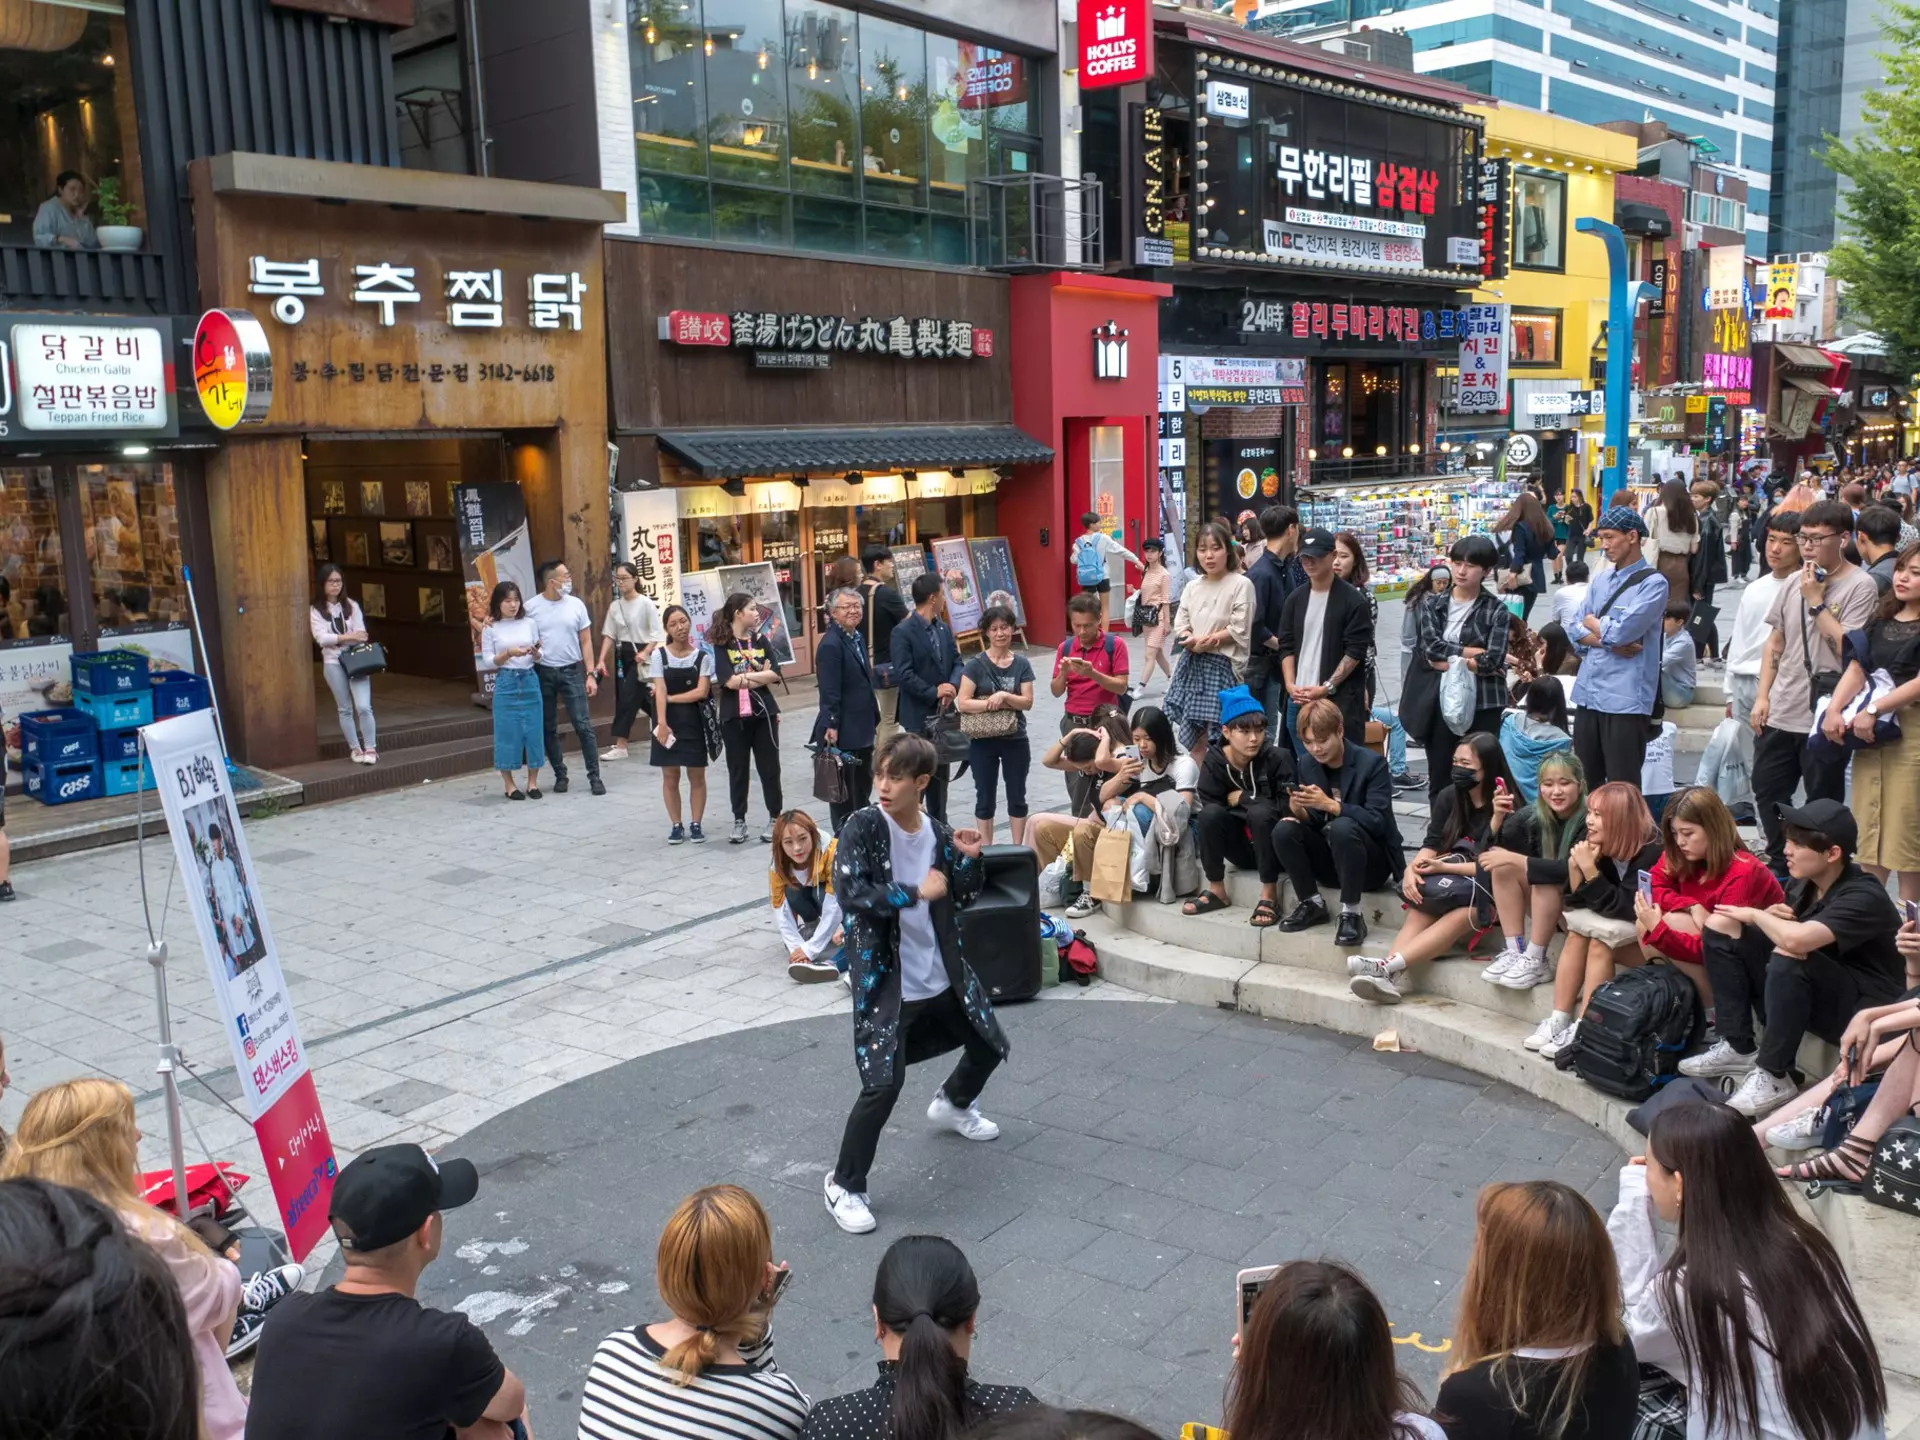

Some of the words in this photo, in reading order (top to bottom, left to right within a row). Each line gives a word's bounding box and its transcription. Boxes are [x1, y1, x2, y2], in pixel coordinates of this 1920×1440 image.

[1087, 38, 1136, 60] HOLLYS
[1087, 54, 1136, 76] COFFEE
[1277, 145, 1372, 206] 무한리필
[1375, 161, 1439, 215] 삼겹살
[1306, 234, 1338, 256] 전지적
[1340, 238, 1381, 260] 참견시점
[1383, 243, 1422, 262] 촬영장소
[248, 256, 588, 331] 봉추찜닭
[1243, 301, 1284, 332] 24時
[1423, 311, 1437, 340] &
[1439, 310, 1468, 342] 포차
[1469, 307, 1497, 320] 찰리
[42, 334, 140, 361] 닭갈비
[1463, 338, 1498, 355] 치킨
[56, 363, 100, 375] Chicken
[104, 363, 131, 375] Galbi
[478, 363, 555, 382] 3142-6618
[1172, 359, 1181, 379] 5
[1475, 357, 1486, 370] &
[1462, 373, 1498, 389] 포차
[33, 384, 158, 410] 철판볶음밥
[1248, 388, 1282, 404] 무한리필
[1461, 391, 1498, 406] 24時
[48, 411, 88, 424] Teppan
[91, 411, 119, 423] Fried
[122, 411, 145, 423] Rice
[631, 526, 661, 618] 丸亀製
[60, 774, 90, 797] Cass
[253, 1036, 299, 1095] 댄스버스킹
